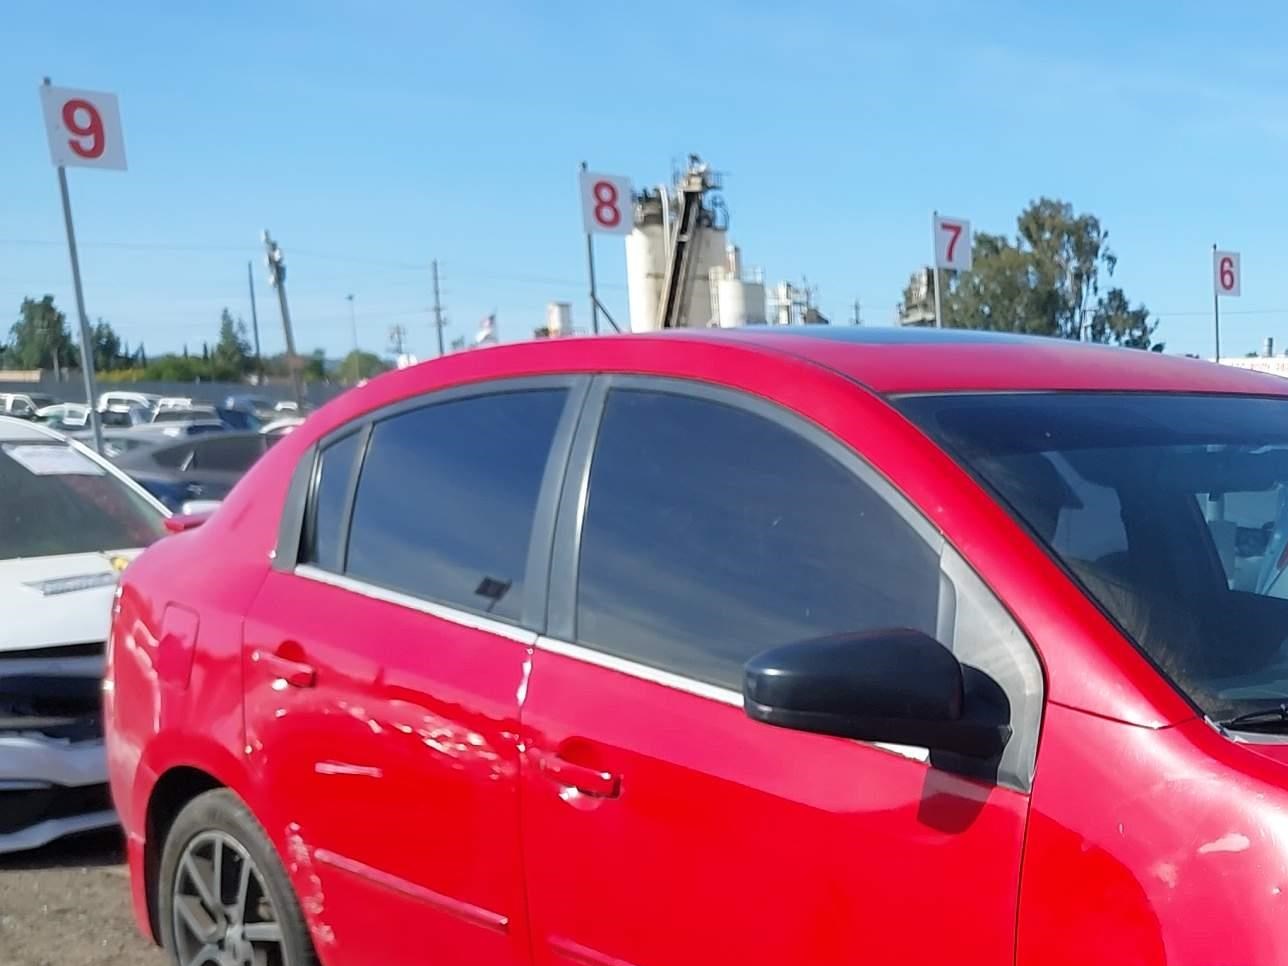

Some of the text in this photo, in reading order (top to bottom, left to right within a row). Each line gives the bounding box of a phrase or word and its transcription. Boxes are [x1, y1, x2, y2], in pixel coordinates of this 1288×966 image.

[62, 99, 105, 159] 9
[594, 181, 620, 228] 8
[941, 222, 962, 263] 7
[1220, 256, 1234, 290] 6
